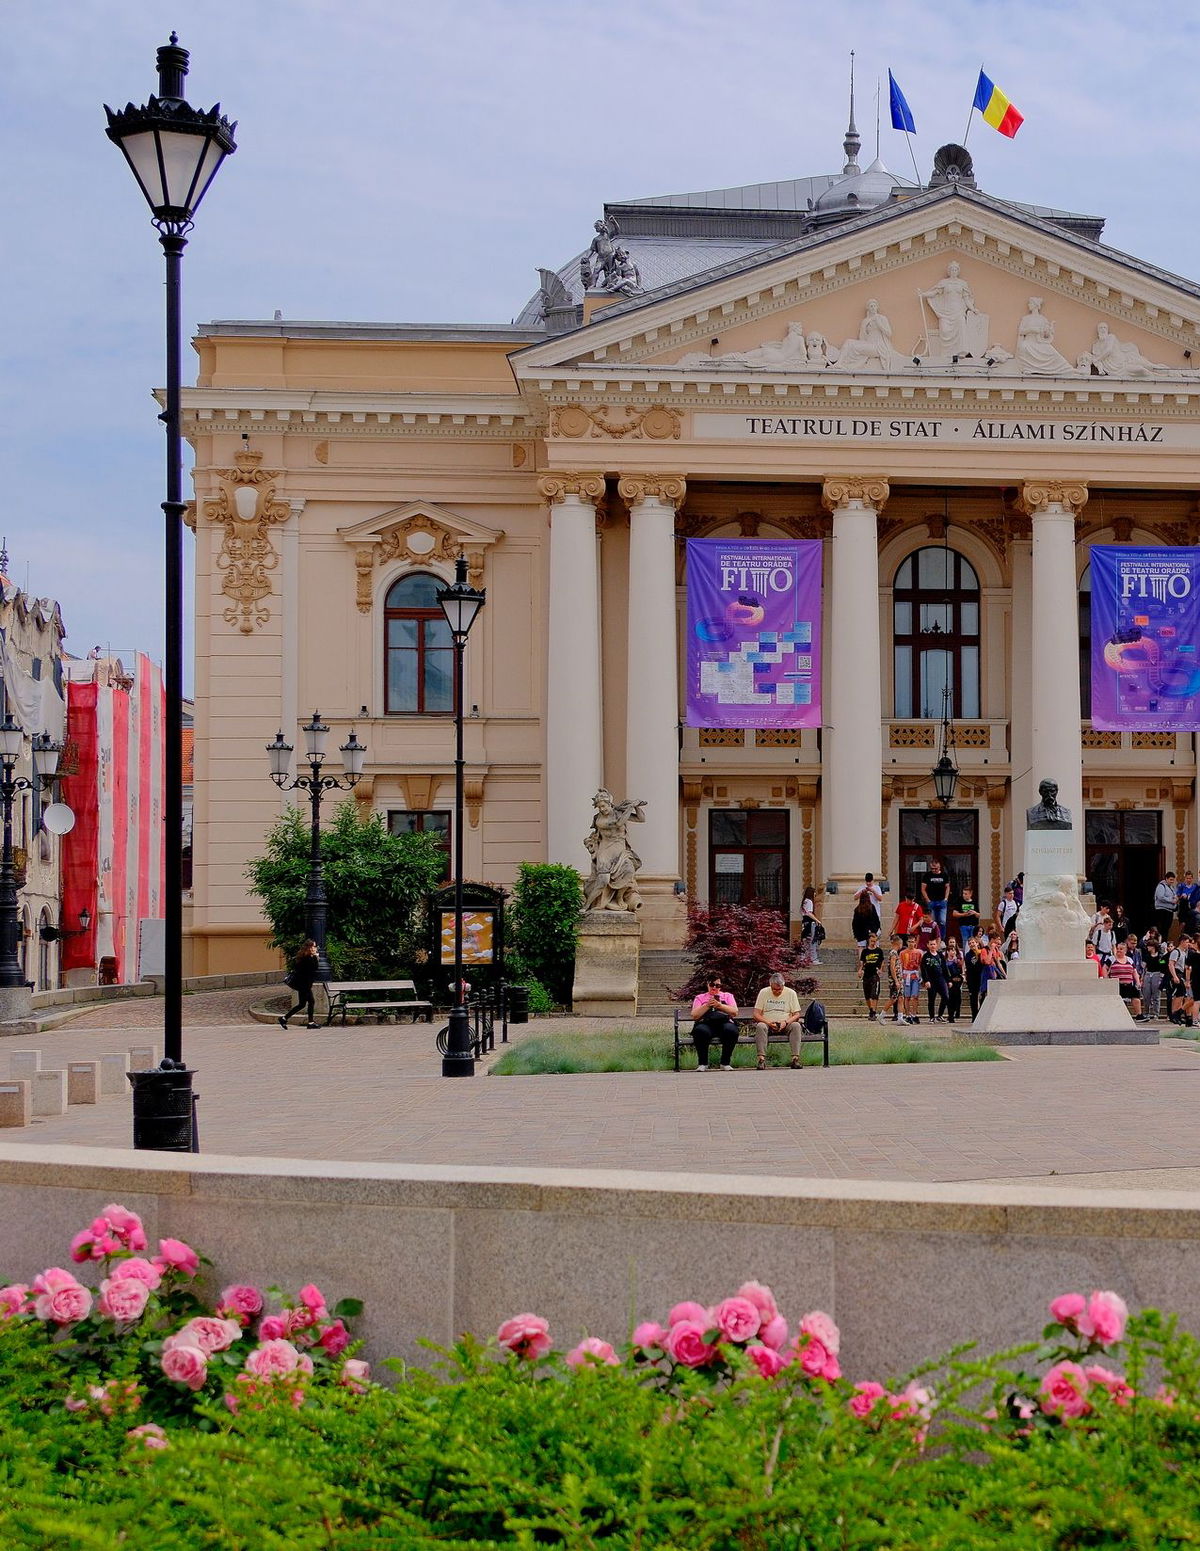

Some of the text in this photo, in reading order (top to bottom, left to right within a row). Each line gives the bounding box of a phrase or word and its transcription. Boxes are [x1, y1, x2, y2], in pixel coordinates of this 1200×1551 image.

[745, 417, 1164, 443] TEATRUL DE STAT ÁLLAMI SZÍNHÁZ
